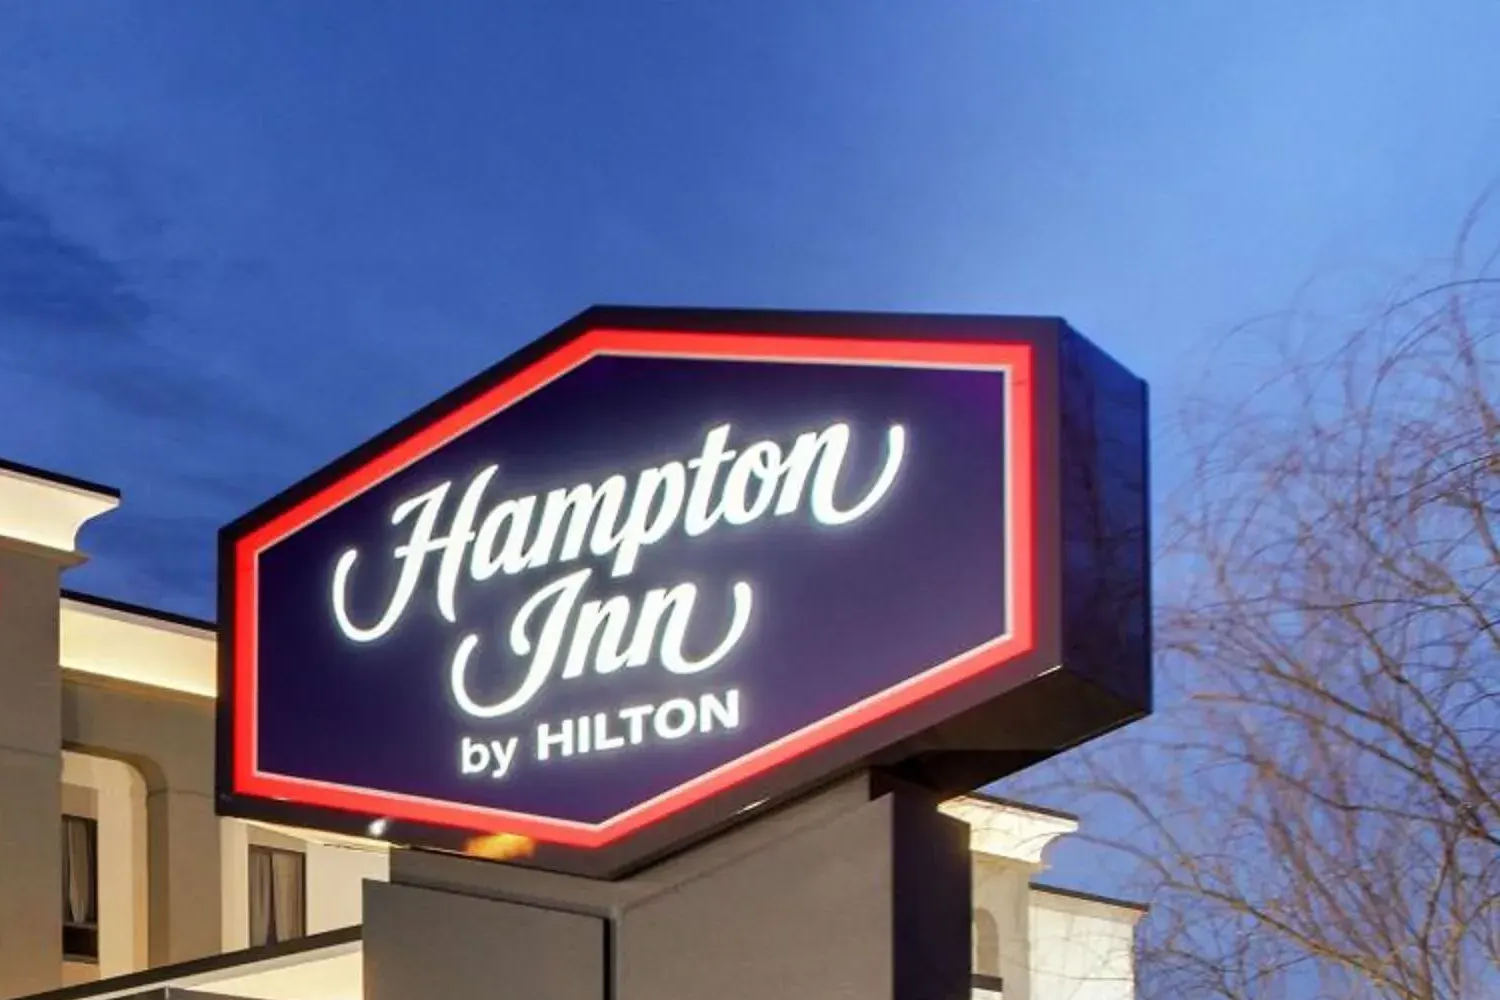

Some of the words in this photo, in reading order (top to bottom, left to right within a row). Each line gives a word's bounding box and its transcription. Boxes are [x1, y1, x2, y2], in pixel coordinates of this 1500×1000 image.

[332, 421, 905, 643] Hampton
[451, 567, 753, 718] Inn
[460, 736, 519, 778] by
[536, 690, 741, 761] HILTON
